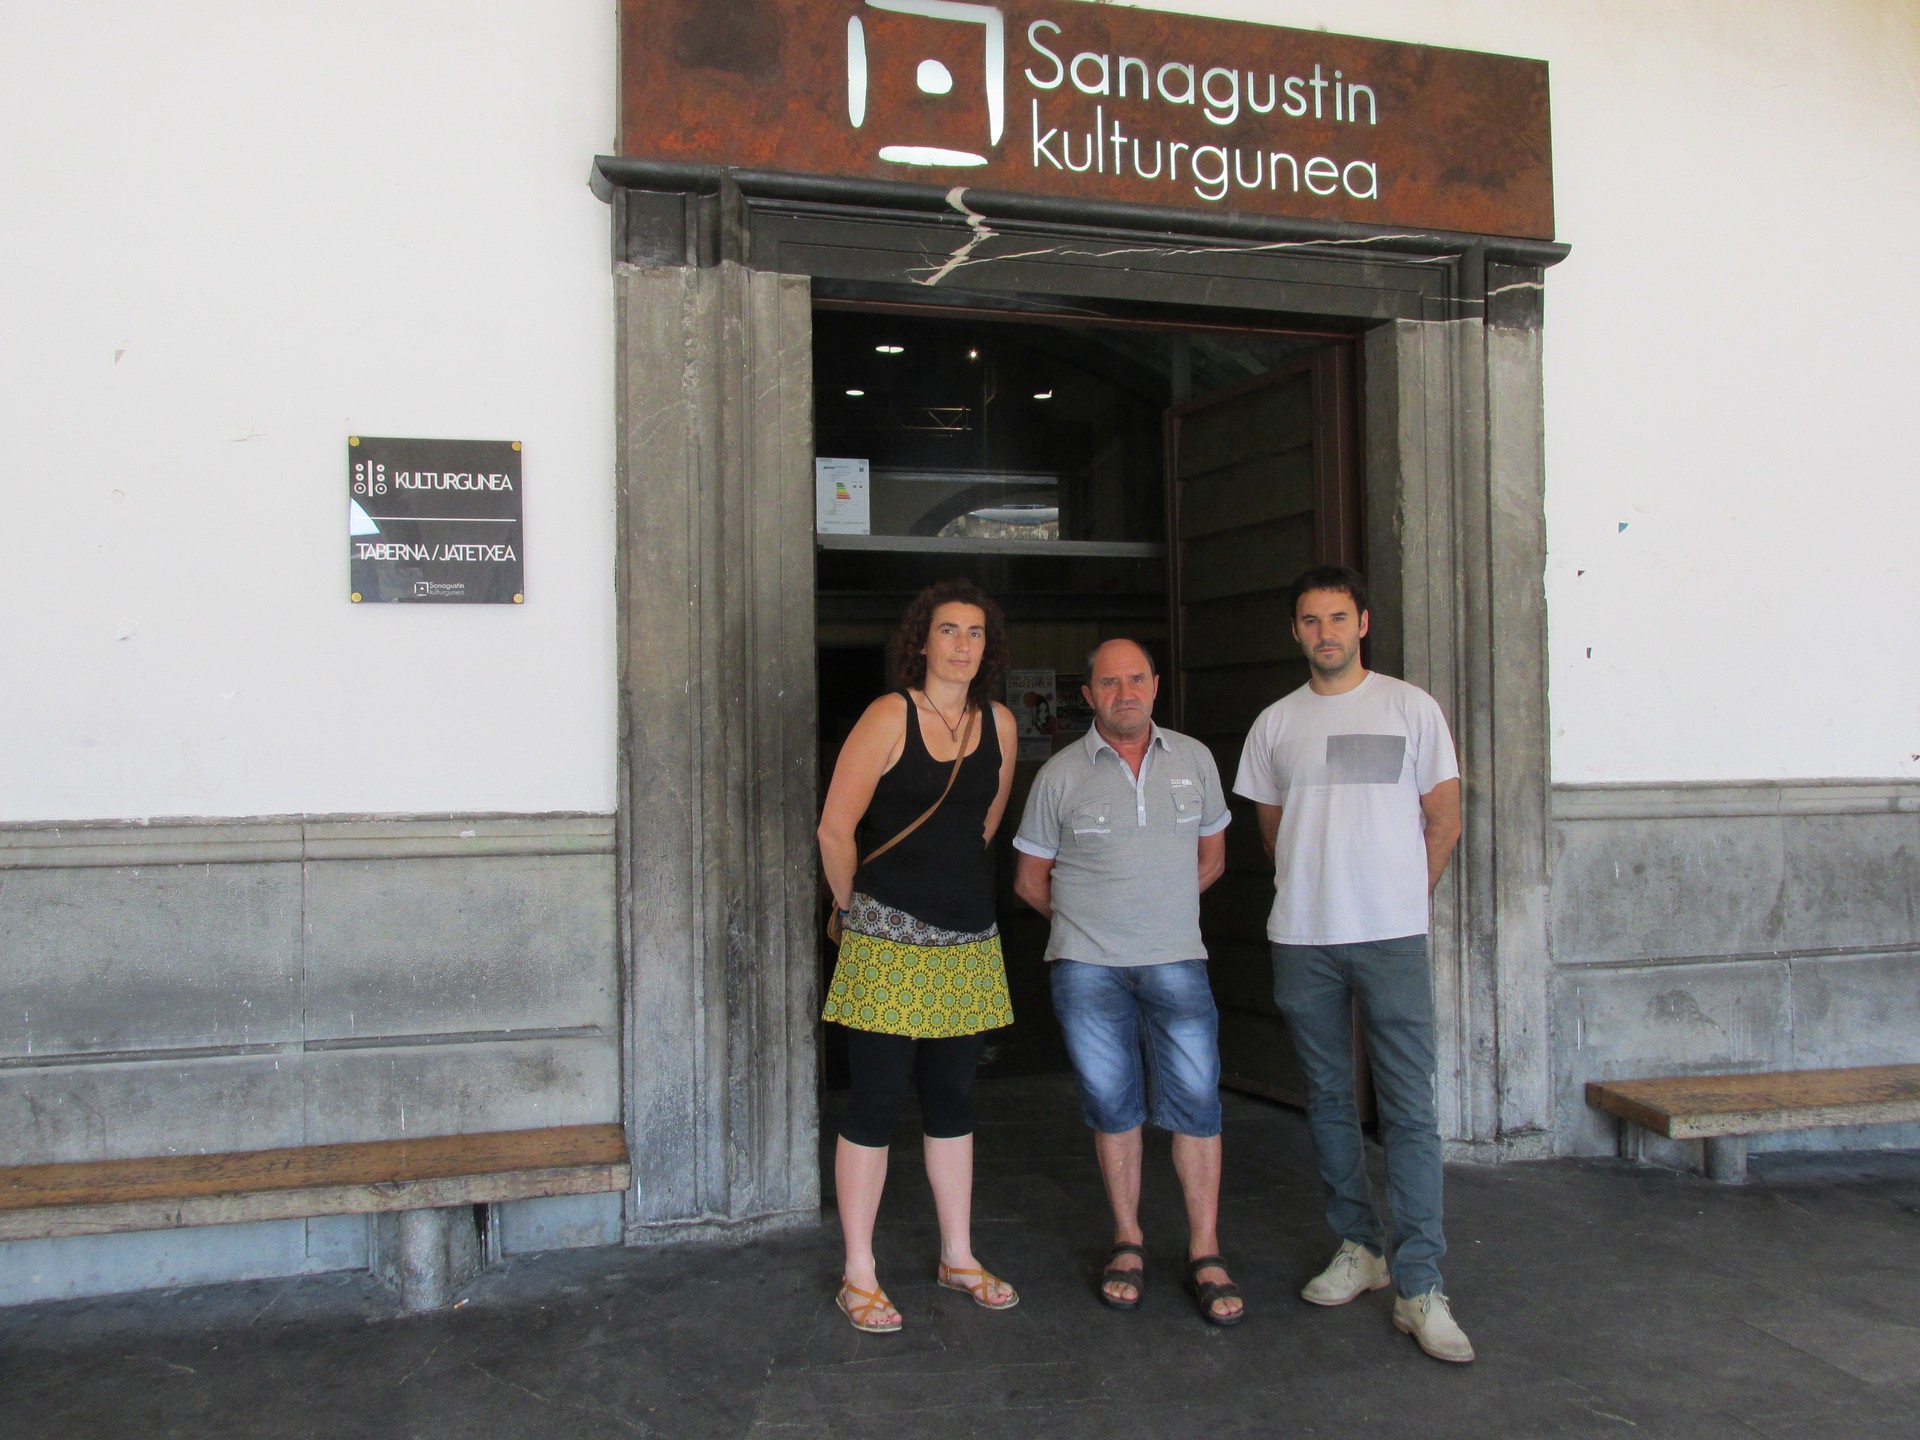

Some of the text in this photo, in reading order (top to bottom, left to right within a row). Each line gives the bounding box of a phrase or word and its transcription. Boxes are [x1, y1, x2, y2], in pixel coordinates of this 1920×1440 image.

[1024, 19, 1377, 126] Sanagustin
[1032, 98, 1378, 201] kulturgunea
[395, 471, 513, 491] KULTURGUNEA
[355, 543, 430, 561] TABERNA
[439, 544, 517, 562] JATETXEA
